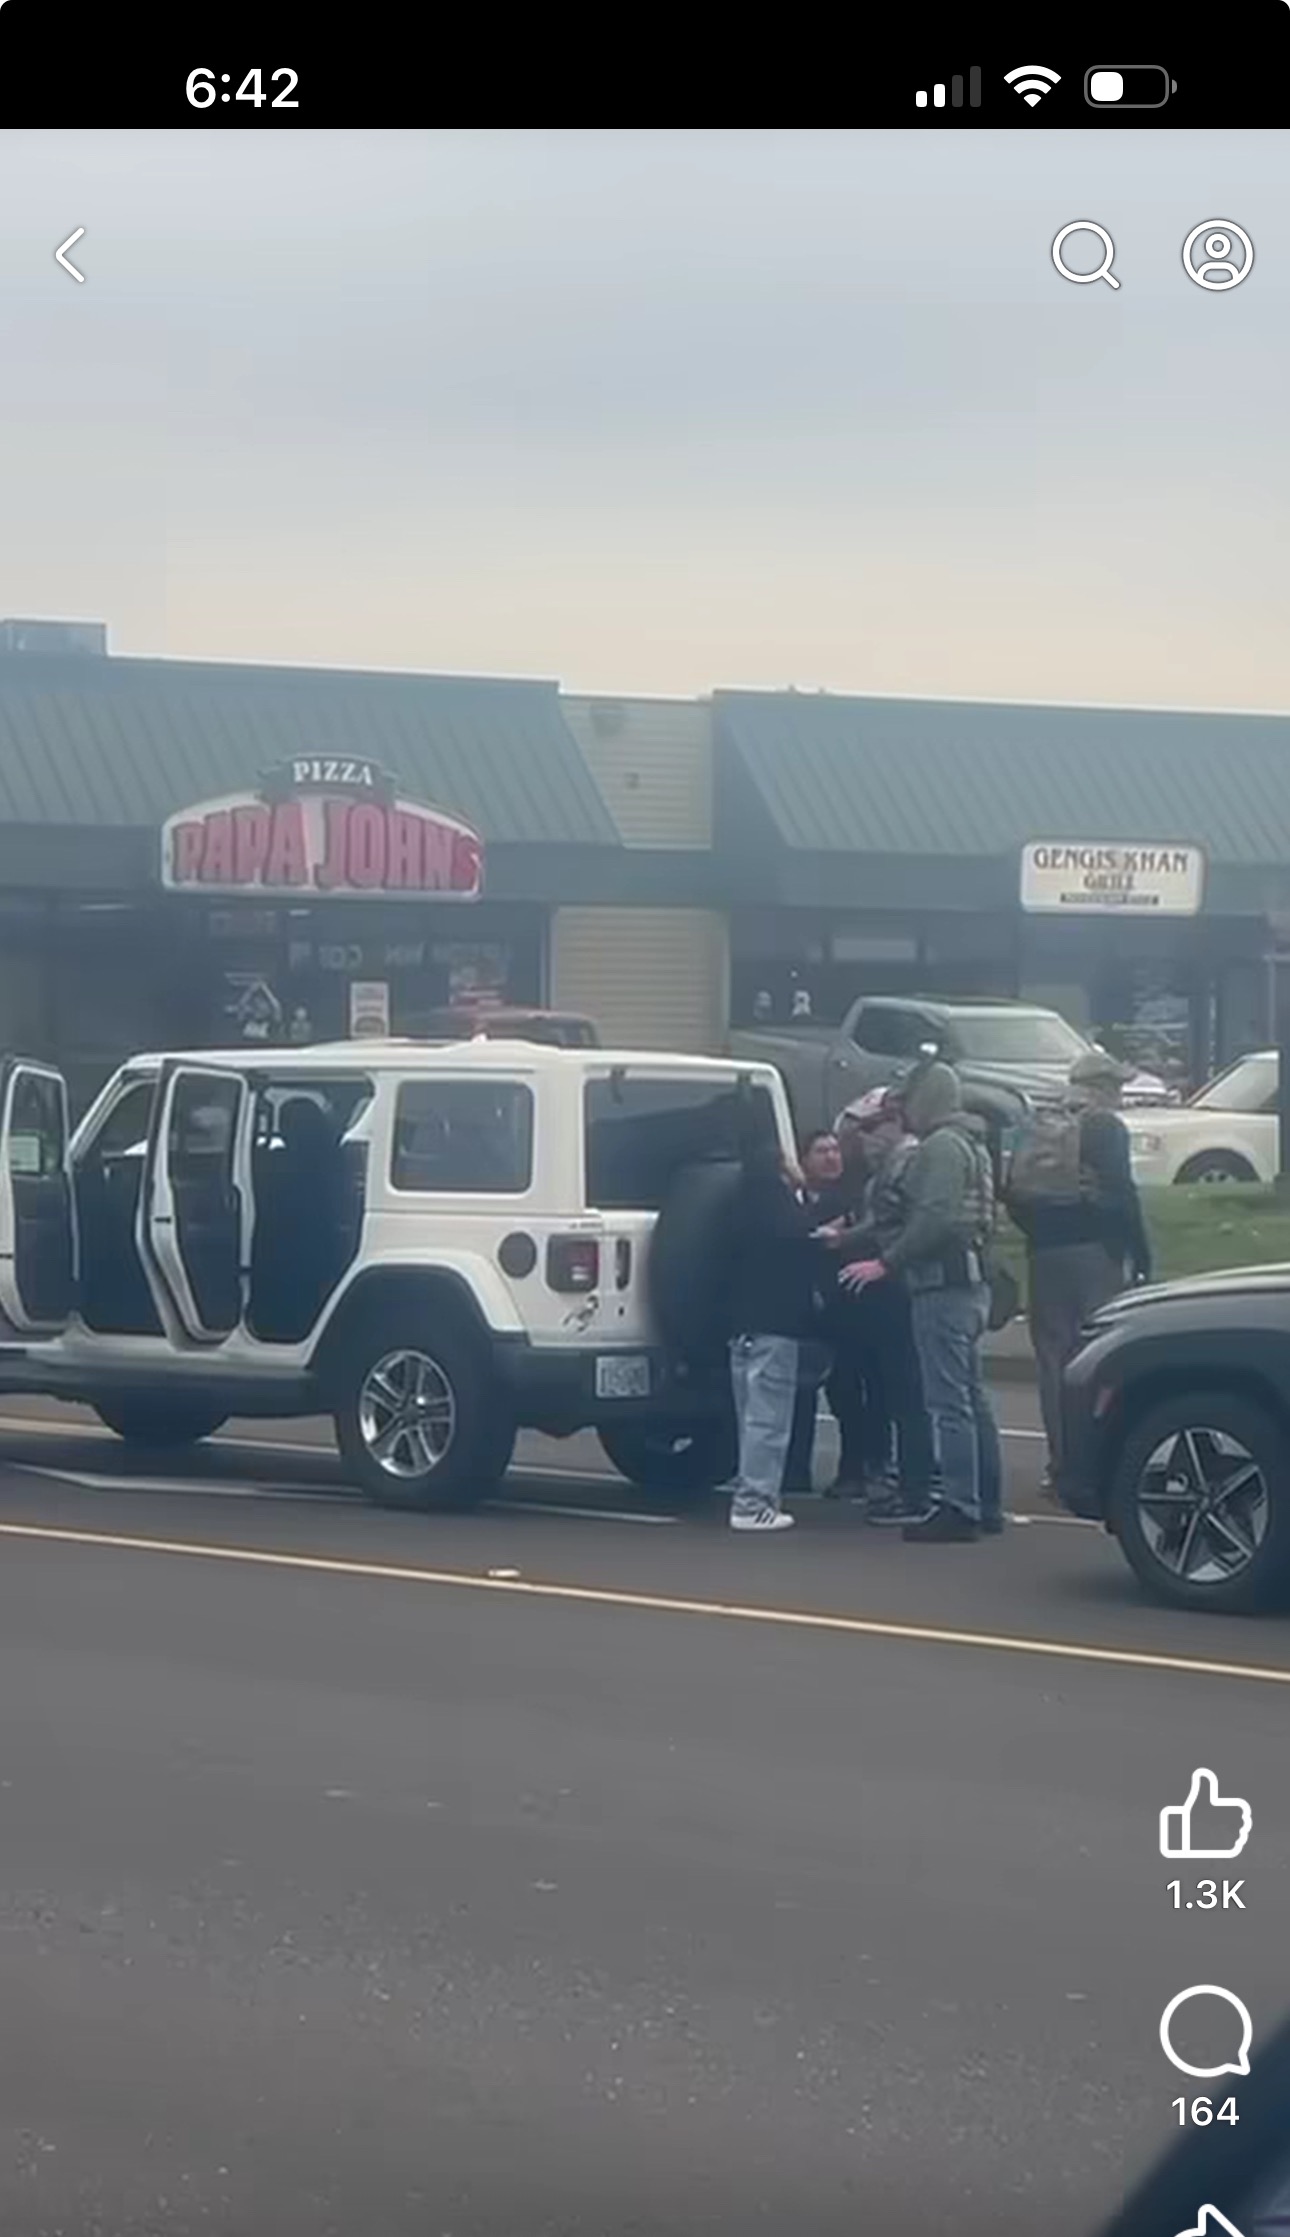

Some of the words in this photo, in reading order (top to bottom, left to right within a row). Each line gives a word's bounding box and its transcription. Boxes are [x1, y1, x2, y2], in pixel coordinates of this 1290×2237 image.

[293, 760, 374, 786] PIZZA
[173, 803, 309, 887] PAPA
[1123, 851, 1189, 873] KHAN
